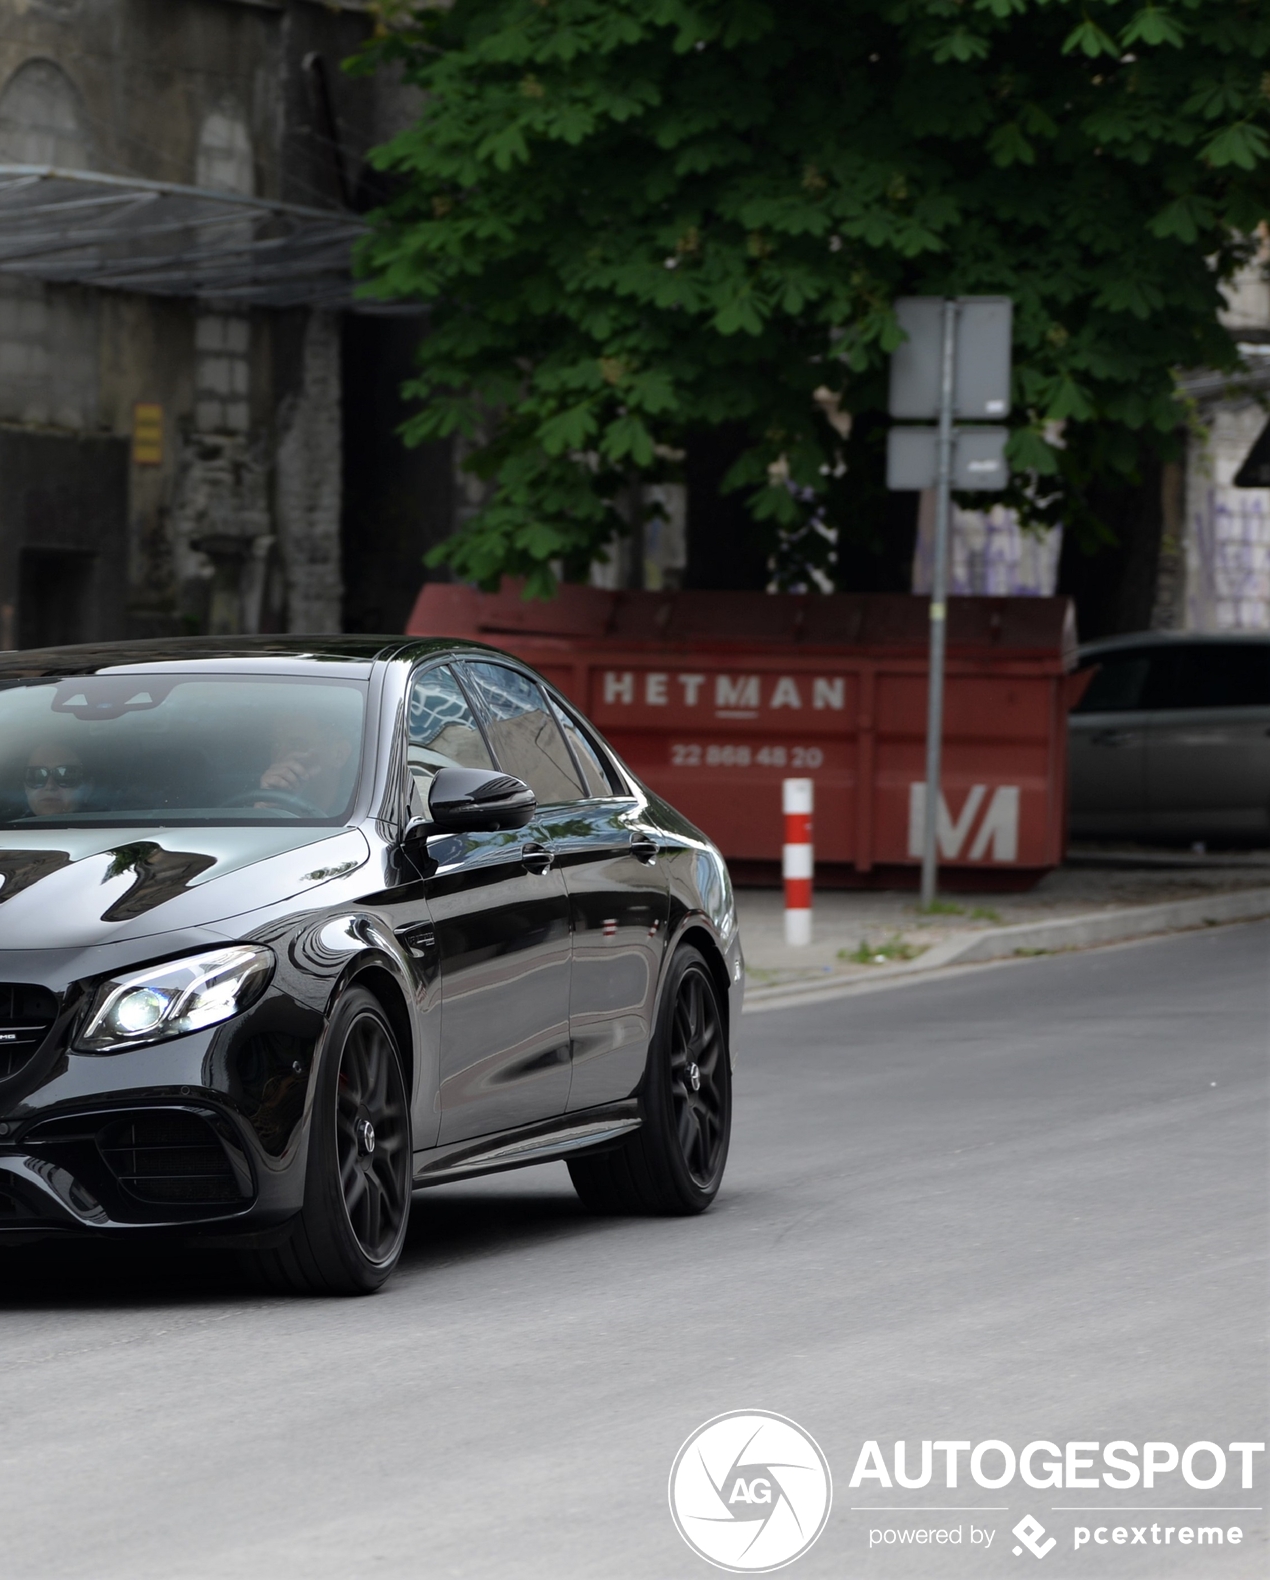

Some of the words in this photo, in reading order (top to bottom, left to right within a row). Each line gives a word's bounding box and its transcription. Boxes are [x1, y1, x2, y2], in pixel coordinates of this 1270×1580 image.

[603, 672, 846, 709] HETMAN
[671, 744, 701, 766] 22
[791, 746, 823, 768] 20
